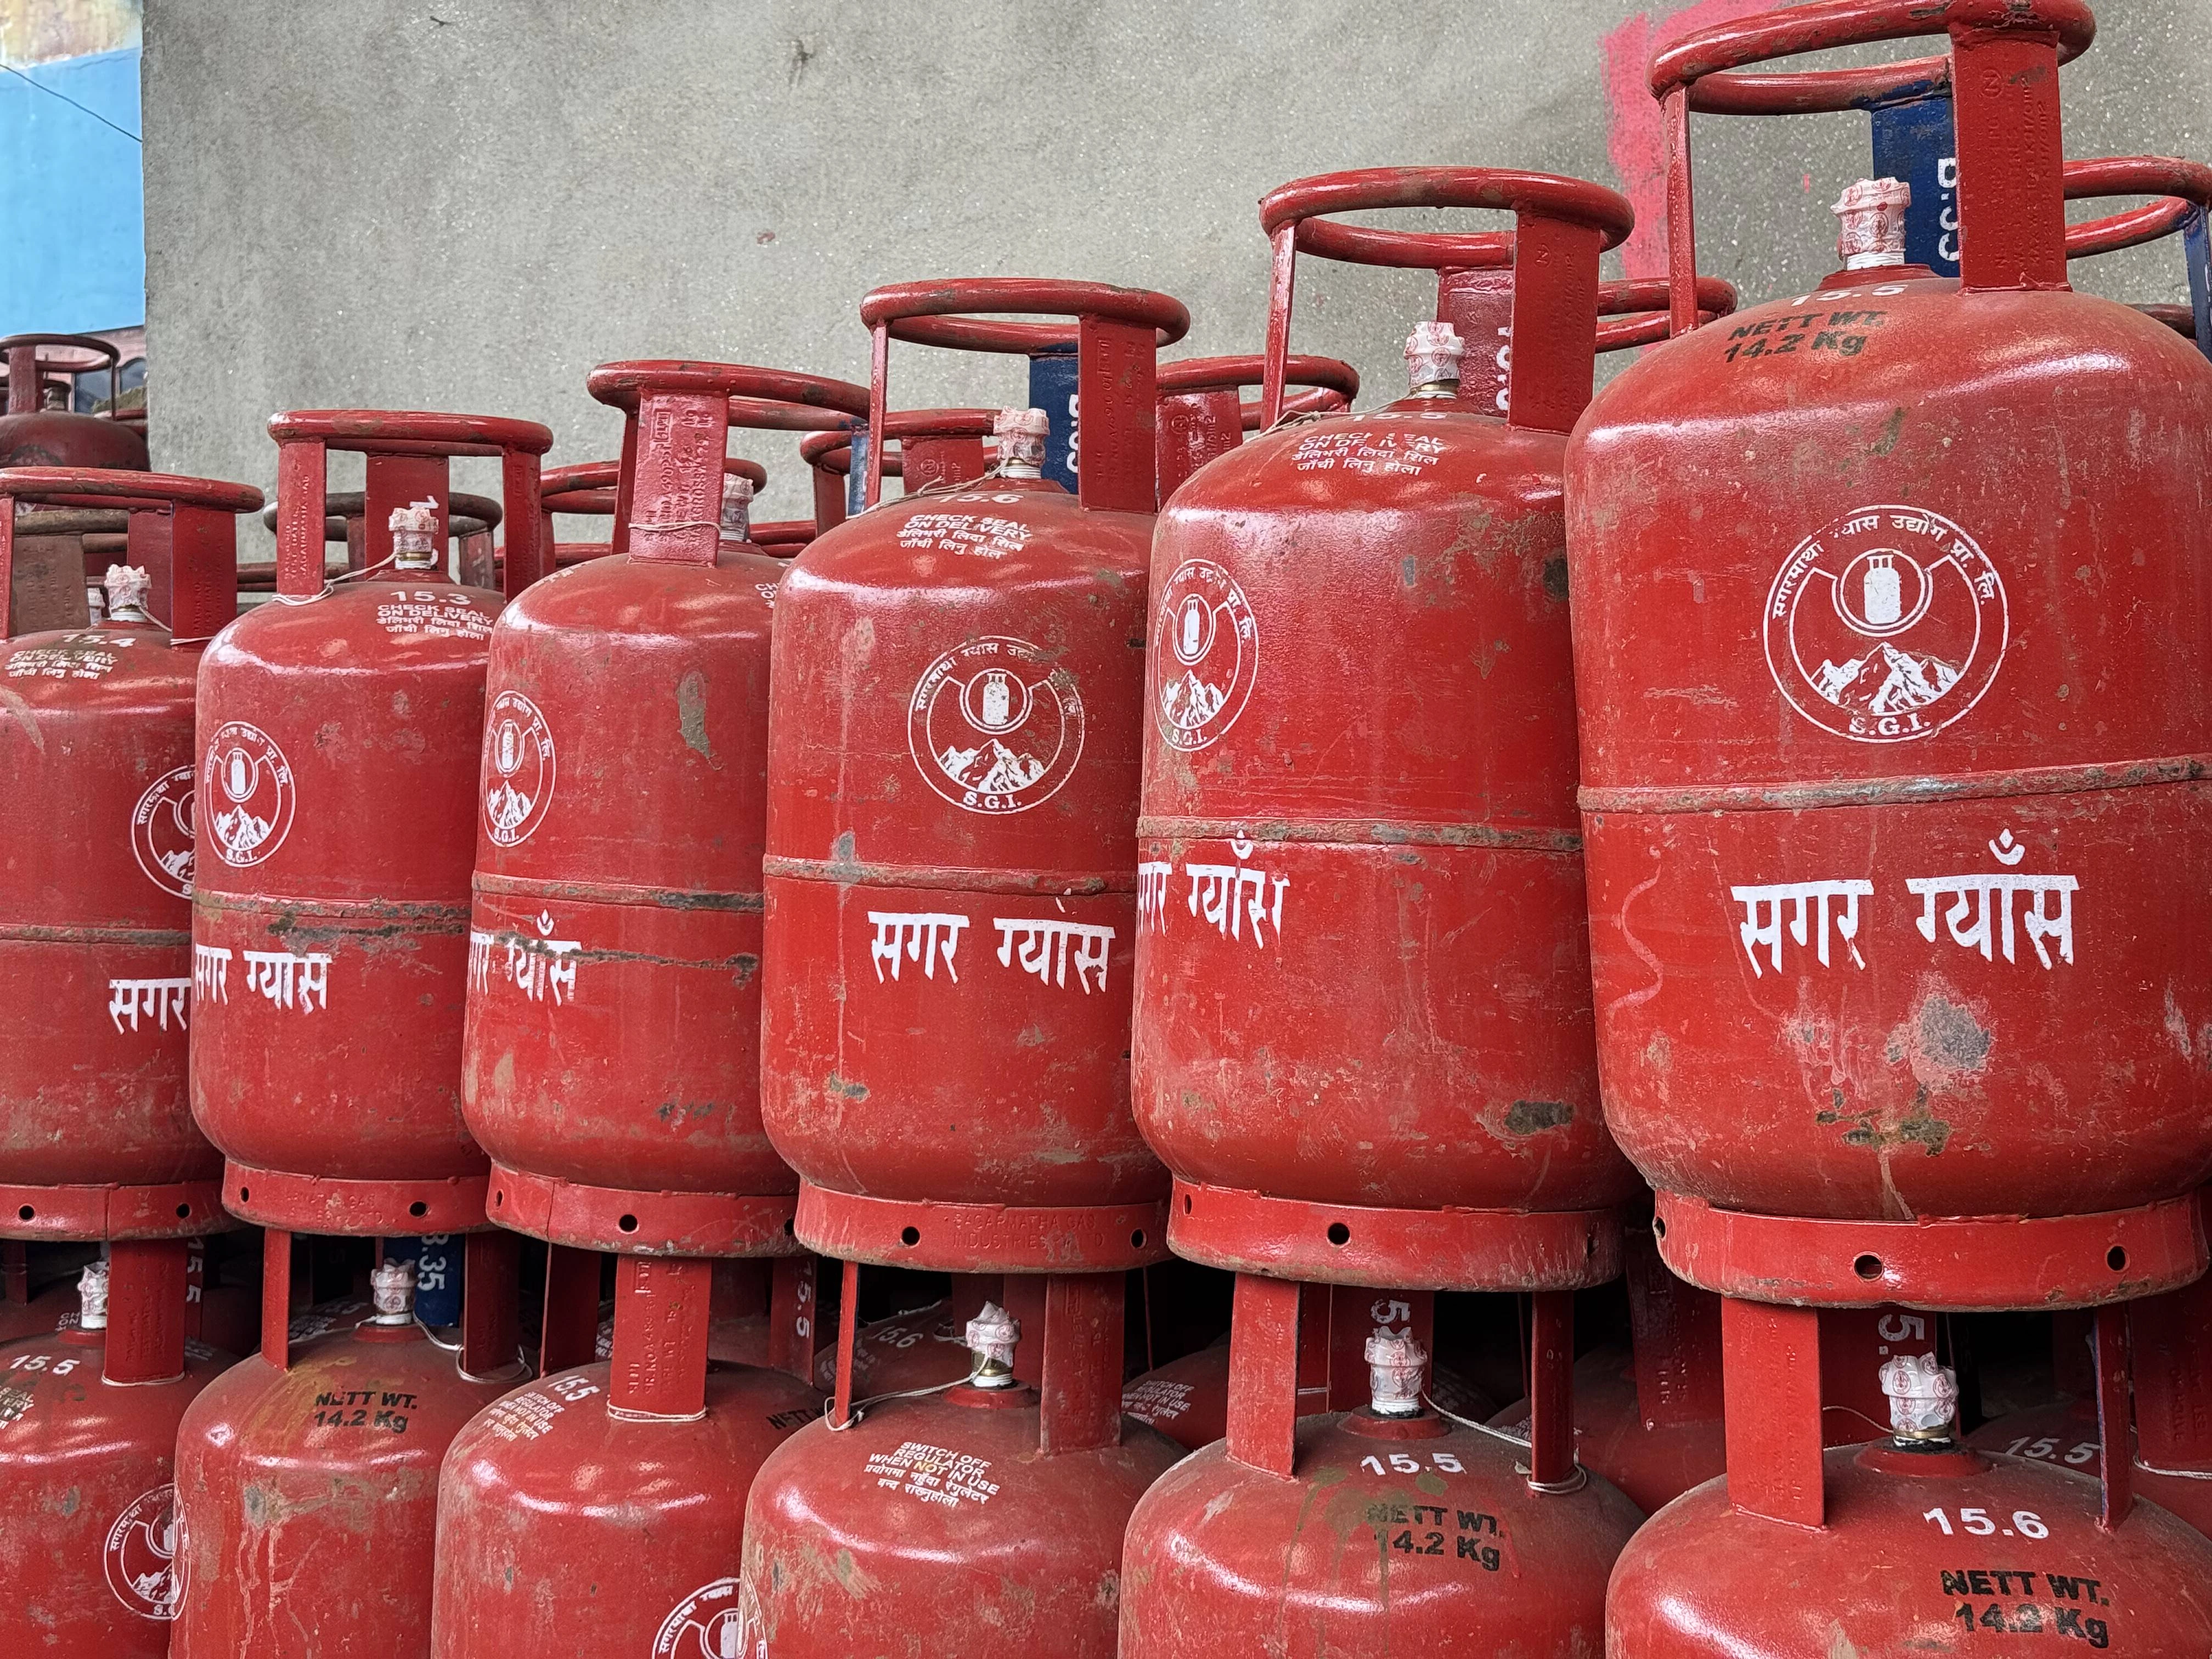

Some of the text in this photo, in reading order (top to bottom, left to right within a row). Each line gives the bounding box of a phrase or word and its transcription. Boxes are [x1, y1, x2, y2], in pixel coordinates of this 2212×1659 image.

[1791, 285, 1909, 307] 15.5
[1728, 313, 1824, 341] NETT
[1724, 331, 1869, 364] 14.2 Kg
[1299, 440, 1330, 450] ON
[1384, 460, 1422, 476] होला
[933, 493, 1024, 504] 15.6
[904, 521, 1034, 541] ON DELIVERY
[910, 514, 1030, 533] CHECK SEAL
[391, 591, 471, 605] 15.3
[1975, 571, 1997, 606] लि.
[377, 604, 440, 613] CHECK
[409, 610, 494, 626] DELIVERY
[62, 634, 137, 648] 15.4
[1849, 713, 1932, 736] S.G.I.
[963, 791, 1022, 809] S.G.I.
[493, 828, 520, 843] S.G.I.
[1730, 879, 1875, 979] सगर
[867, 911, 970, 984] सगर
[110, 977, 192, 1035] सगर
[867, 1325, 924, 1348] 15.6
[9, 1355, 81, 1376] 15.5
[548, 1374, 601, 1402] 15.5
[381, 1392, 418, 1410] WT.
[546, 1401, 566, 1414] OFF
[314, 1409, 409, 1434] 14.2 Kg
[533, 1418, 554, 1435] USE
[900, 1442, 992, 1469] SWITCH OFF
[2005, 1436, 2101, 1464] 15.5
[868, 1453, 1001, 1496] WHEN NOT IN USE
[893, 1448, 985, 1479] REGULATOR
[1361, 1453, 1467, 1475] 15.5
[1923, 1508, 2049, 1539] 15.6
[1457, 1535, 1500, 1572] Kg
[1940, 1570, 2111, 1607] NETT WT.
[1955, 1602, 2110, 1650] 14.2 Kg
